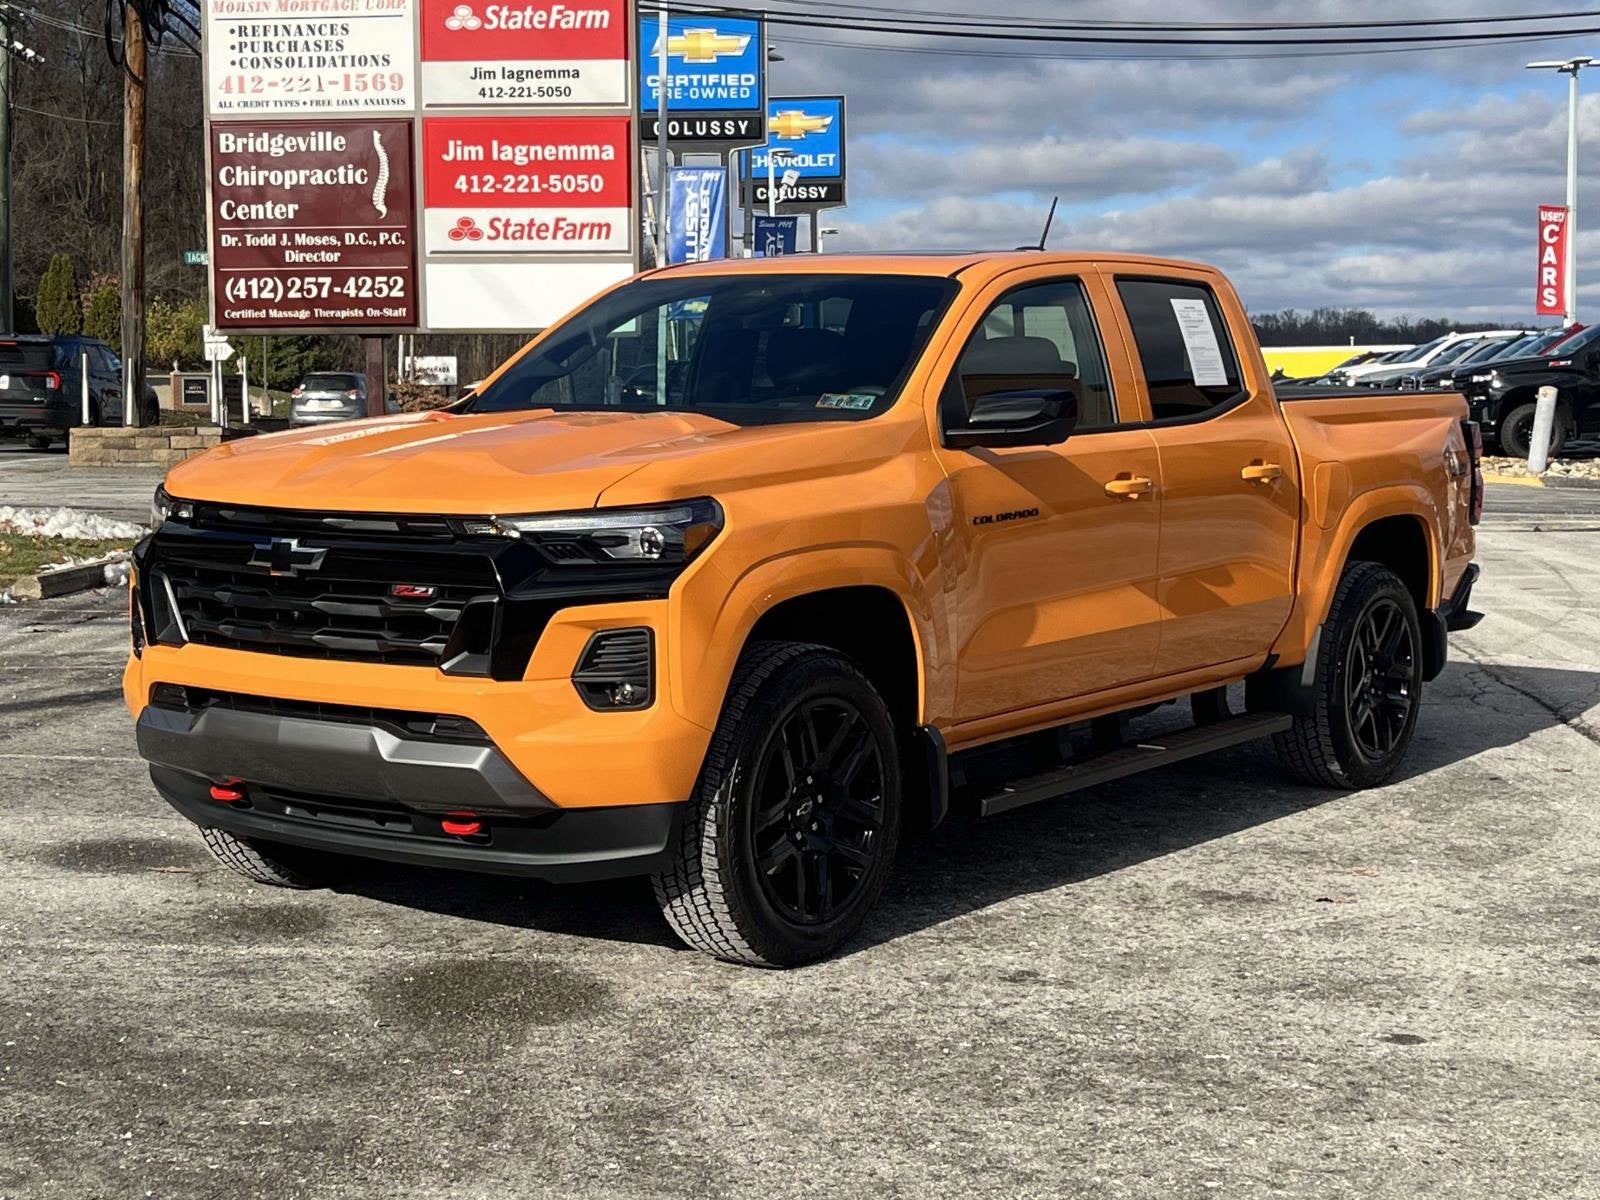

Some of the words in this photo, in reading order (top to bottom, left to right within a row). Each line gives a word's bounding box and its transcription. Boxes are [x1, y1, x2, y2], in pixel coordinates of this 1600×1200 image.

[276, 0, 360, 12] MORTGAGE
[237, 23, 350, 37] REFINANCES
[238, 39, 345, 53] PURCHASES
[238, 54, 391, 69] CONSOLIDATIONS
[470, 67, 496, 80] Jim
[502, 66, 580, 82] Iagnemma
[646, 74, 756, 87] CERTIFIED
[218, 72, 404, 94] 412-221-1569
[478, 86, 572, 98] 412-221-5050
[652, 87, 751, 99] PRE-OWNED
[217, 100, 234, 109] ALL
[237, 100, 271, 108] CREDIT
[273, 99, 301, 108] TYPES
[309, 99, 333, 107] FREE
[336, 98, 360, 106] LOAN
[363, 97, 406, 107] ANALYSIS
[218, 131, 347, 157] Bridgeville
[442, 140, 484, 161] Jim
[492, 139, 615, 166] Iagnemma
[218, 164, 368, 189] Chiropractic
[454, 174, 604, 193] 412-221-5050
[219, 200, 299, 220] Center
[1541, 211, 1565, 222] USED
[221, 234, 242, 247] Dr.
[245, 233, 277, 247] Todd
[280, 233, 292, 246] J.
[294, 233, 341, 247] Moses,
[344, 232, 377, 247] D.C.,
[379, 232, 405, 245] P.C.
[285, 250, 341, 263] Director
[1542, 223, 1560, 308] CARS
[224, 309, 266, 319] Certified
[268, 308, 311, 319] Massage
[313, 308, 364, 319] Therapists
[366, 307, 407, 317] On-Staff
[972, 508, 1039, 525] COLORADO
[392, 584, 434, 597] Z71
